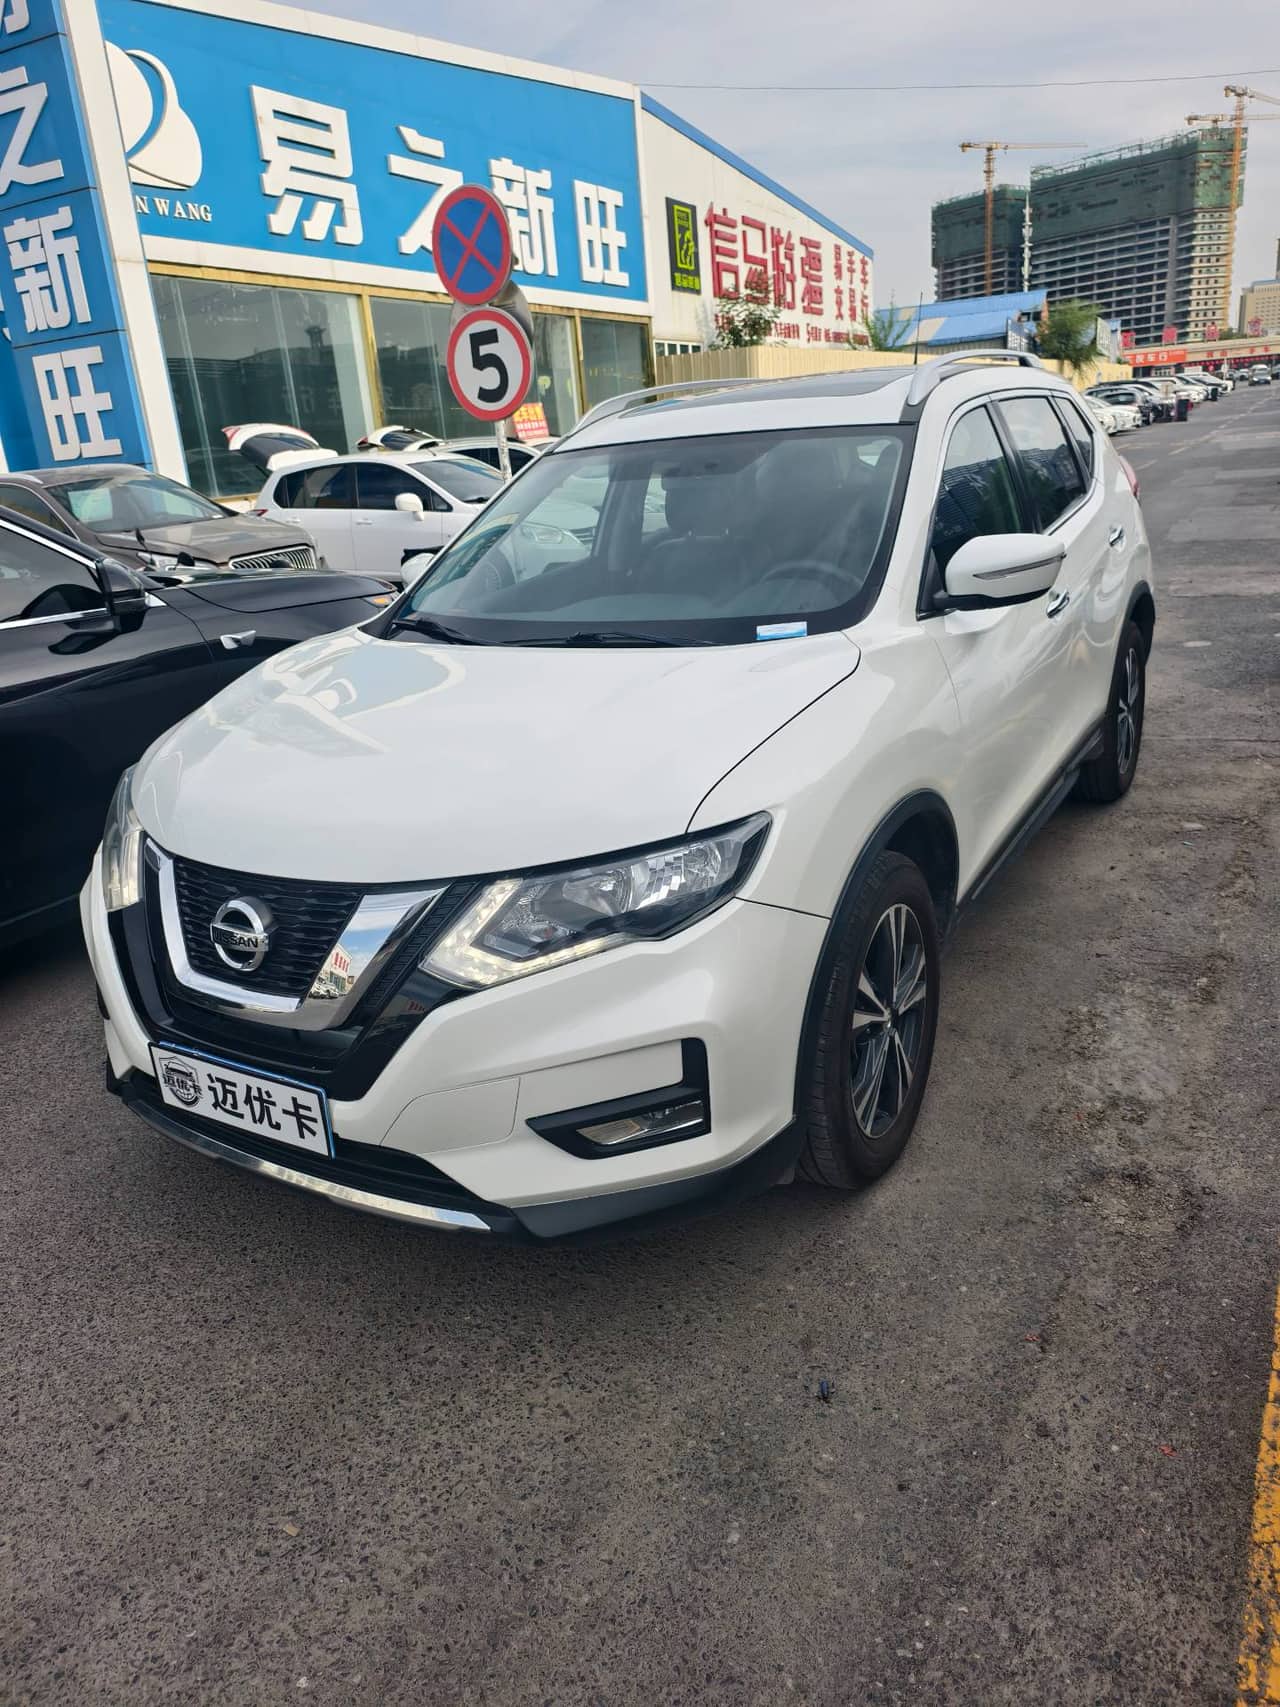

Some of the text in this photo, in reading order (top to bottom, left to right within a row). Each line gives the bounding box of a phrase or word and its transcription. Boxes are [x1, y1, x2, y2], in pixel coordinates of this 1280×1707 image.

[153, 197, 212, 222] WANG
[250, 85, 630, 287] 易之新旺
[0, 0, 123, 462] 之新旺
[469, 328, 510, 404] 5
[213, 927, 260, 949] NISSAN
[162, 1073, 319, 1140] 迈优卡 迈优卡
